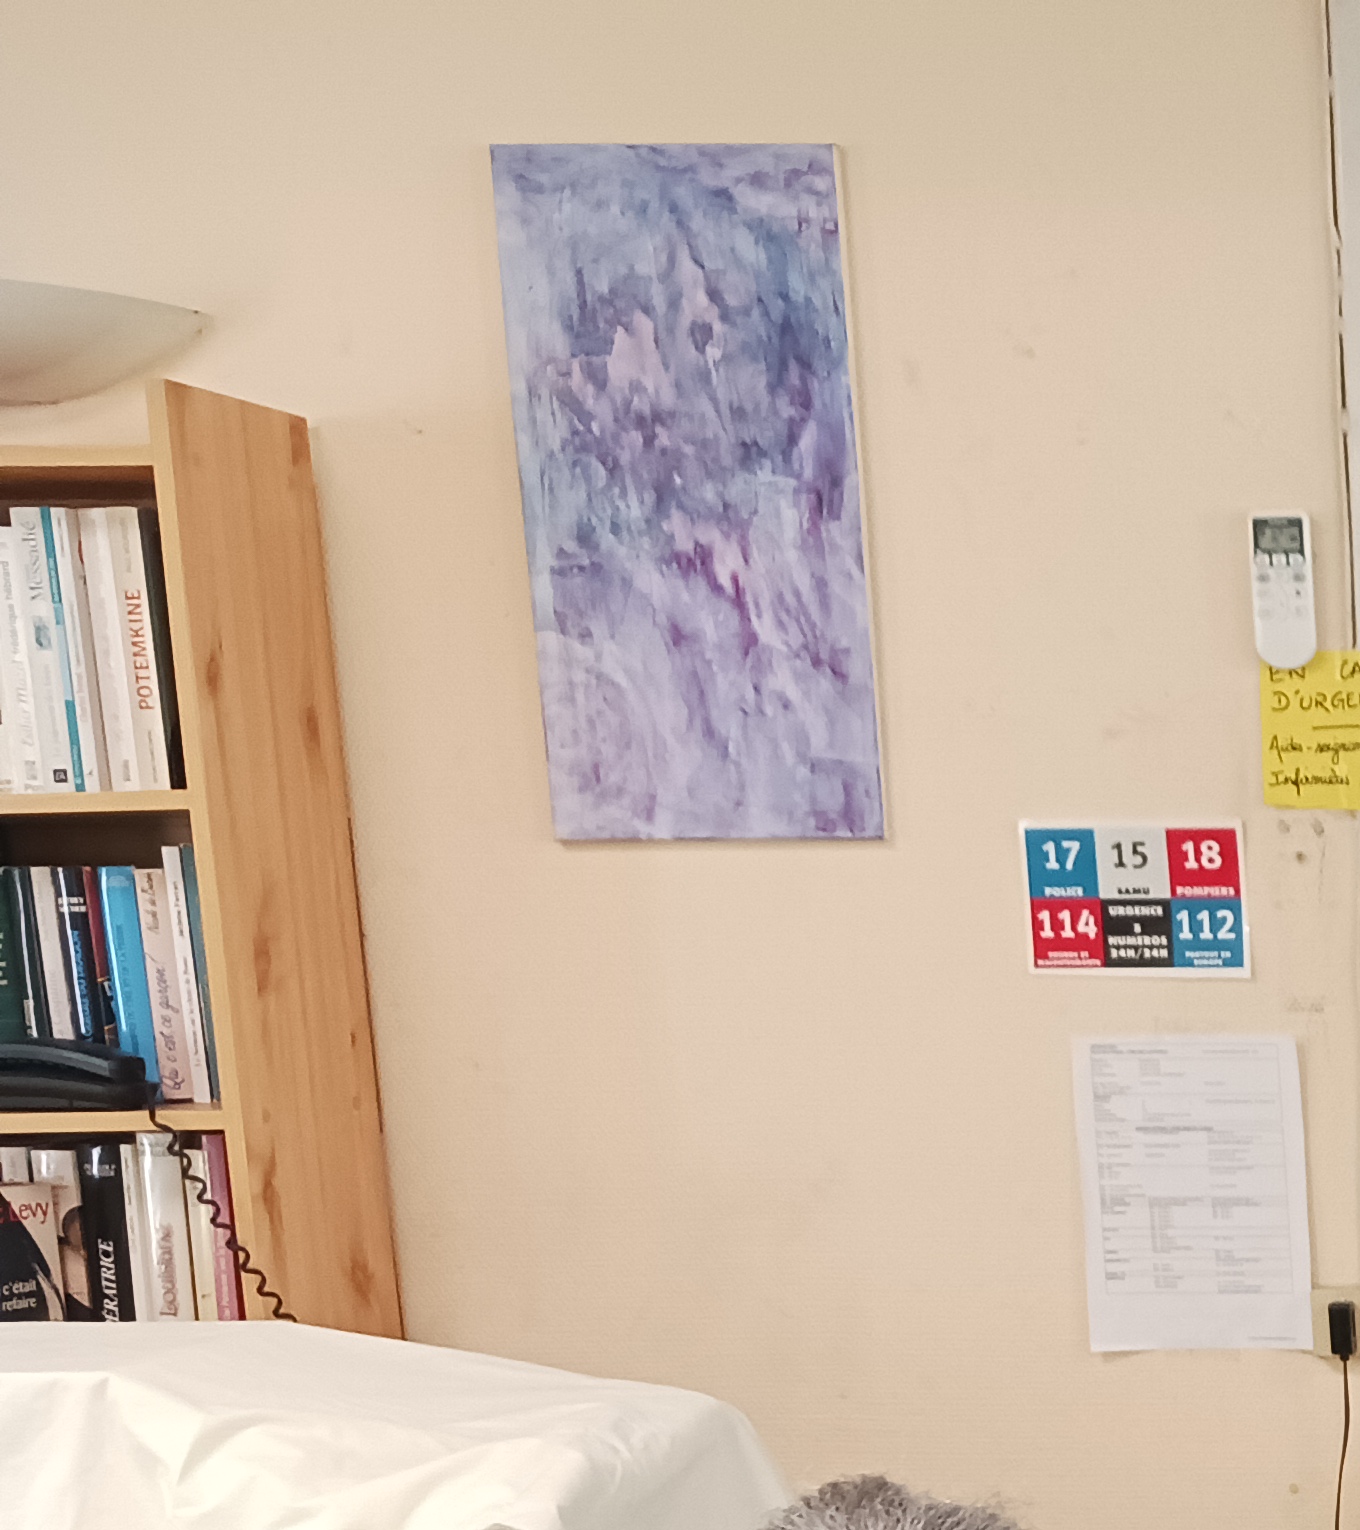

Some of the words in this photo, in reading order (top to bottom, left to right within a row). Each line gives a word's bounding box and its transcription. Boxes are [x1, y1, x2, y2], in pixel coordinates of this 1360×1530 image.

[124, 588, 155, 711] POTEMKINE
[1041, 839, 1081, 871] 17
[1110, 840, 1149, 870] 15
[1181, 839, 1223, 871] 18
[1036, 908, 1098, 940] 114
[1175, 909, 1237, 941] 112
[9, 1201, 49, 1225] Levy
